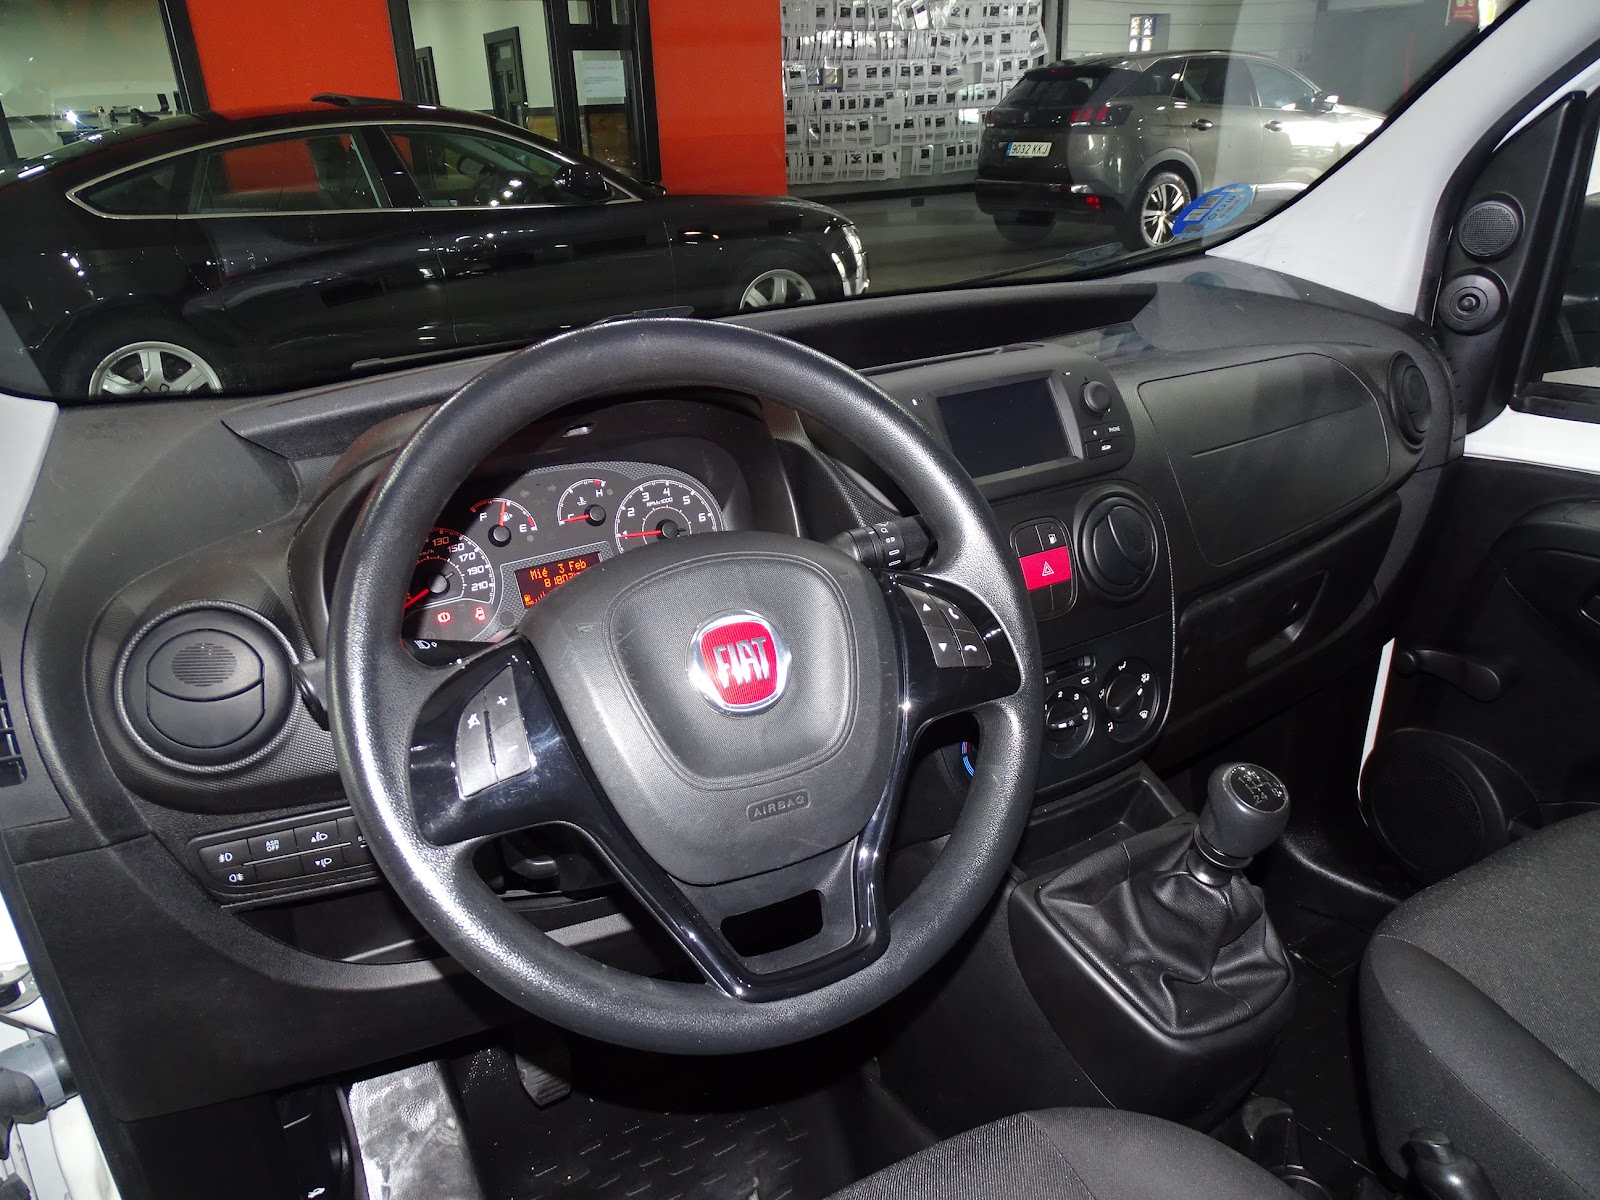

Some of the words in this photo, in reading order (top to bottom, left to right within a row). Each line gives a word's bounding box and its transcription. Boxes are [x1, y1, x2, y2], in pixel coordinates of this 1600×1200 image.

[1011, 144, 1031, 155] 9032
[1032, 144, 1049, 155] KKJ
[595, 489, 604, 498] H
[641, 492, 650, 502] 3
[662, 487, 671, 497] 4
[682, 495, 691, 505] 5
[479, 512, 488, 522] F
[627, 507, 636, 518] 2
[698, 512, 707, 523] 6
[519, 523, 528, 533] E
[432, 536, 450, 547] 130
[447, 542, 465, 553] 150
[458, 551, 476, 563] 170
[466, 564, 485, 576] 190
[529, 567, 548, 581] Mié
[557, 563, 566, 574] 3
[568, 559, 587, 571] Feb
[471, 580, 489, 592] 210
[713, 635, 771, 689] FIAT
[754, 795, 804, 817] AIRBAG
